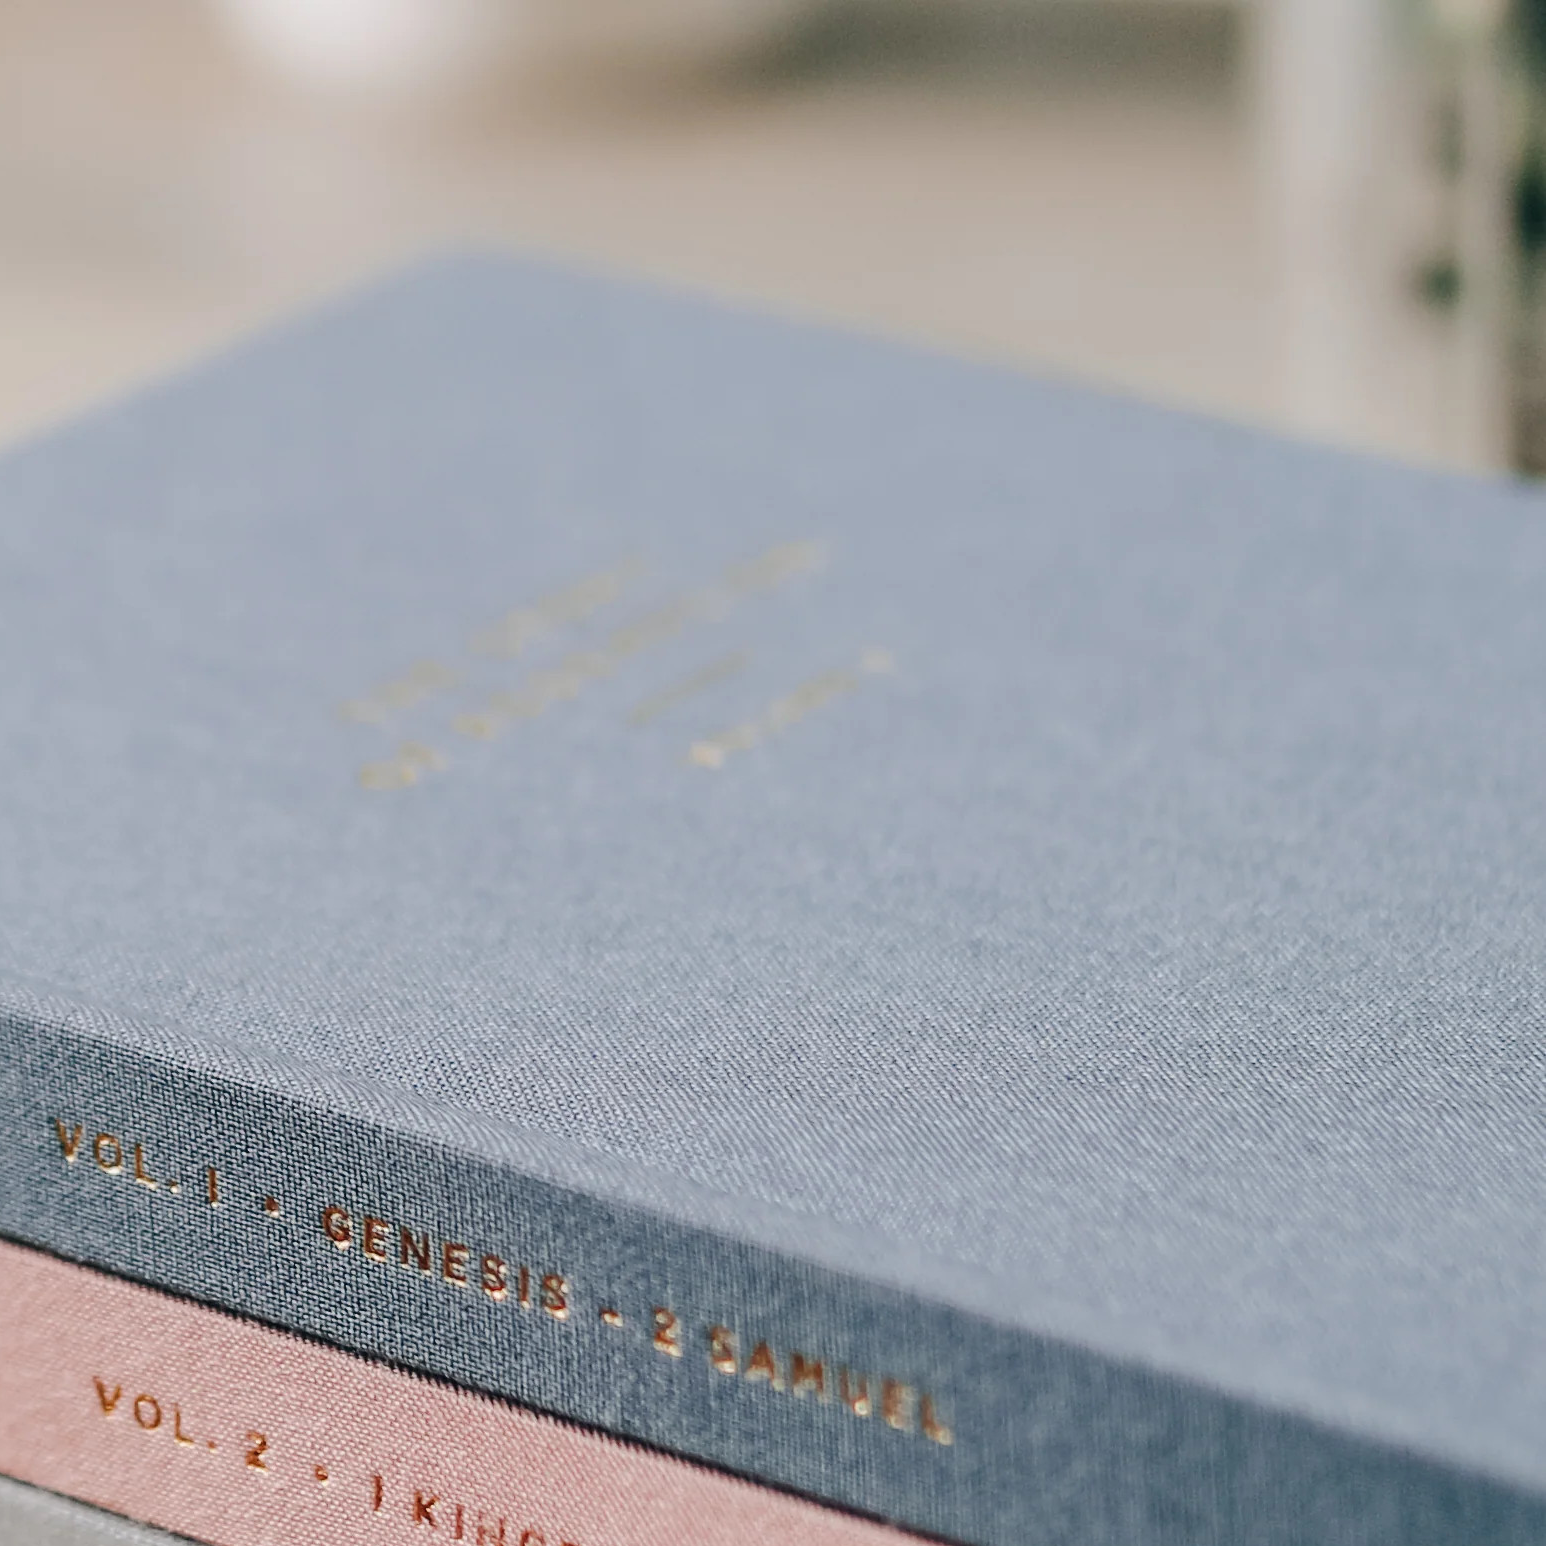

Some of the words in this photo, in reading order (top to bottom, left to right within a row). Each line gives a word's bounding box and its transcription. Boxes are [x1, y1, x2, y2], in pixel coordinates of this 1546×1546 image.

[56, 1118, 181, 1194] VOL.
[321, 1205, 569, 1321] GENESIS
[653, 1306, 684, 1358] 2
[708, 1322, 953, 1447] SAMUEL
[92, 1375, 218, 1452] VOL.
[244, 1431, 269, 1473] 2
